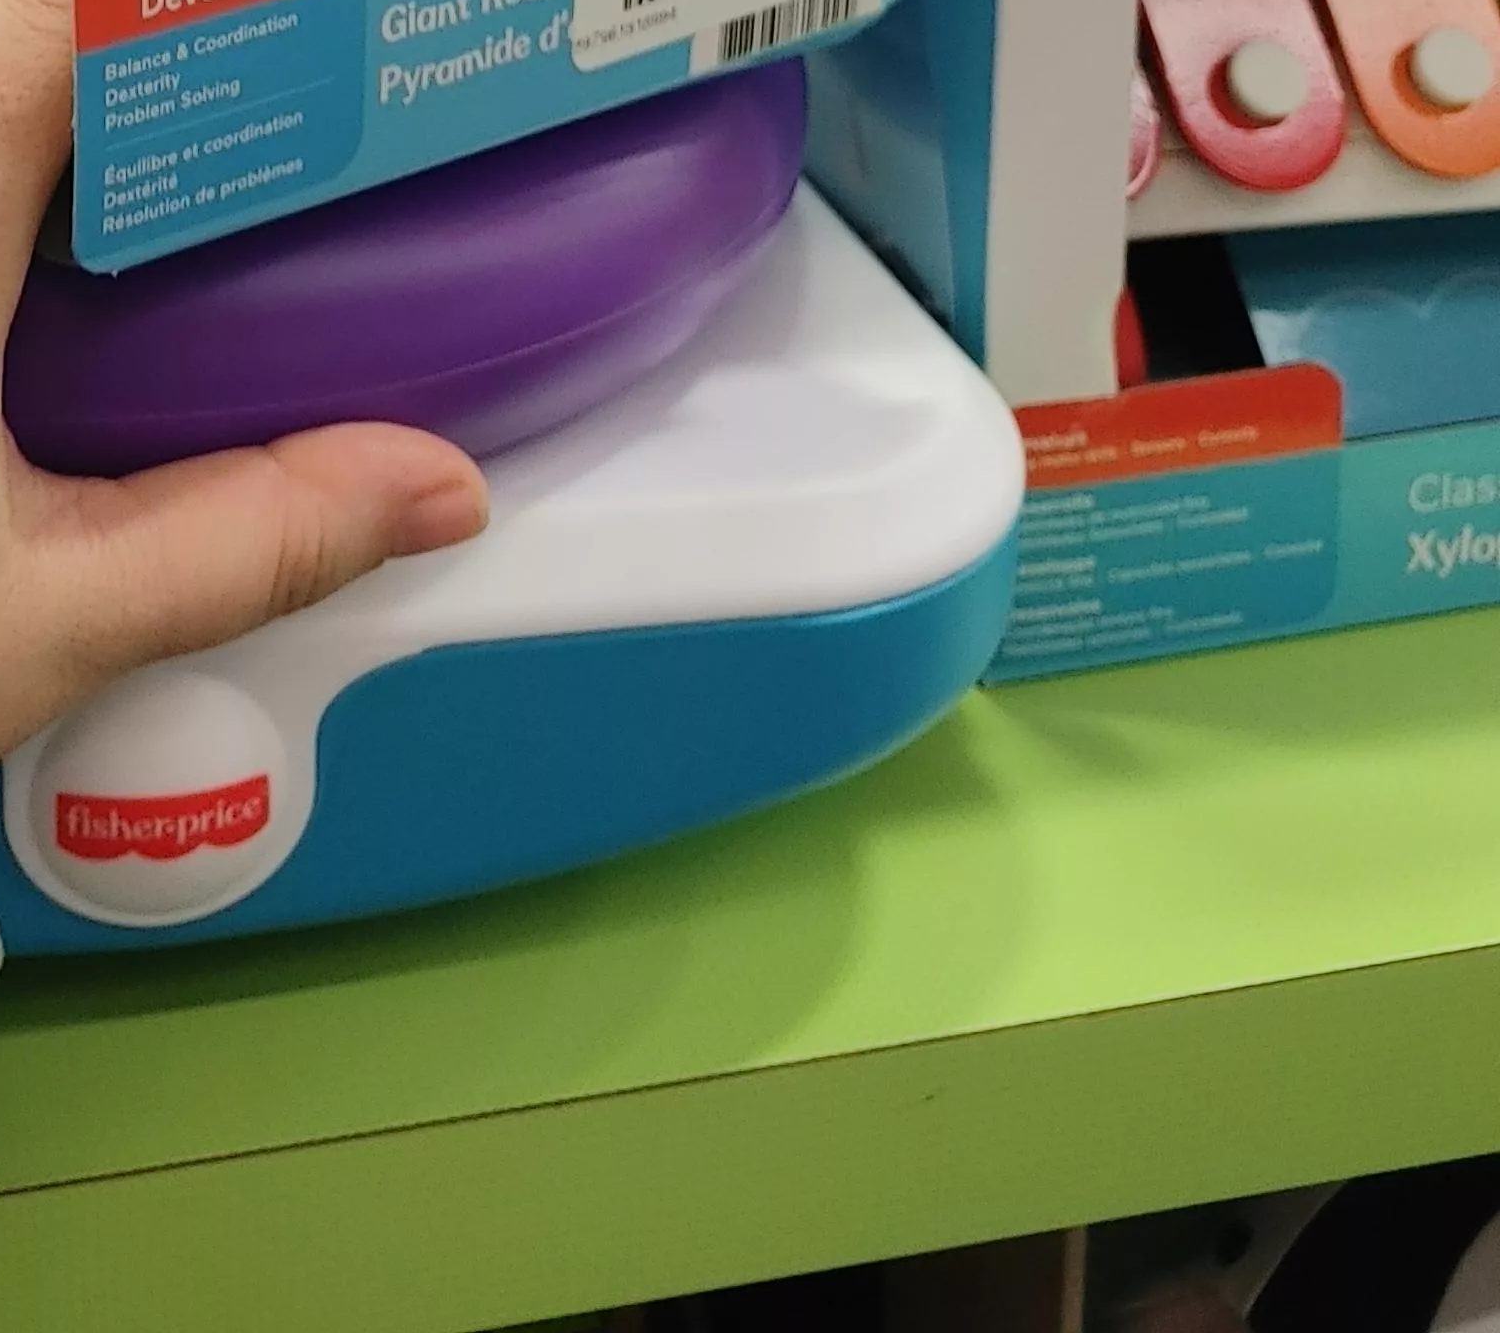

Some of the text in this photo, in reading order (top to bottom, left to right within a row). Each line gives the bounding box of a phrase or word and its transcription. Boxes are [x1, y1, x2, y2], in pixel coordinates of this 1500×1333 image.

[104, 12, 299, 82] Balance & Coordination
[379, 27, 532, 106] Pyramide
[538, 9, 574, 53] d'
[104, 72, 181, 107] Dexterity
[104, 79, 241, 132] Problem Solving
[104, 111, 304, 185] Équilibre et coordination
[102, 157, 304, 235] Résolution de problèmes
[103, 172, 179, 210] Dextérité
[1406, 523, 1500, 579] Xylo
[65, 795, 261, 845] fisher-price
